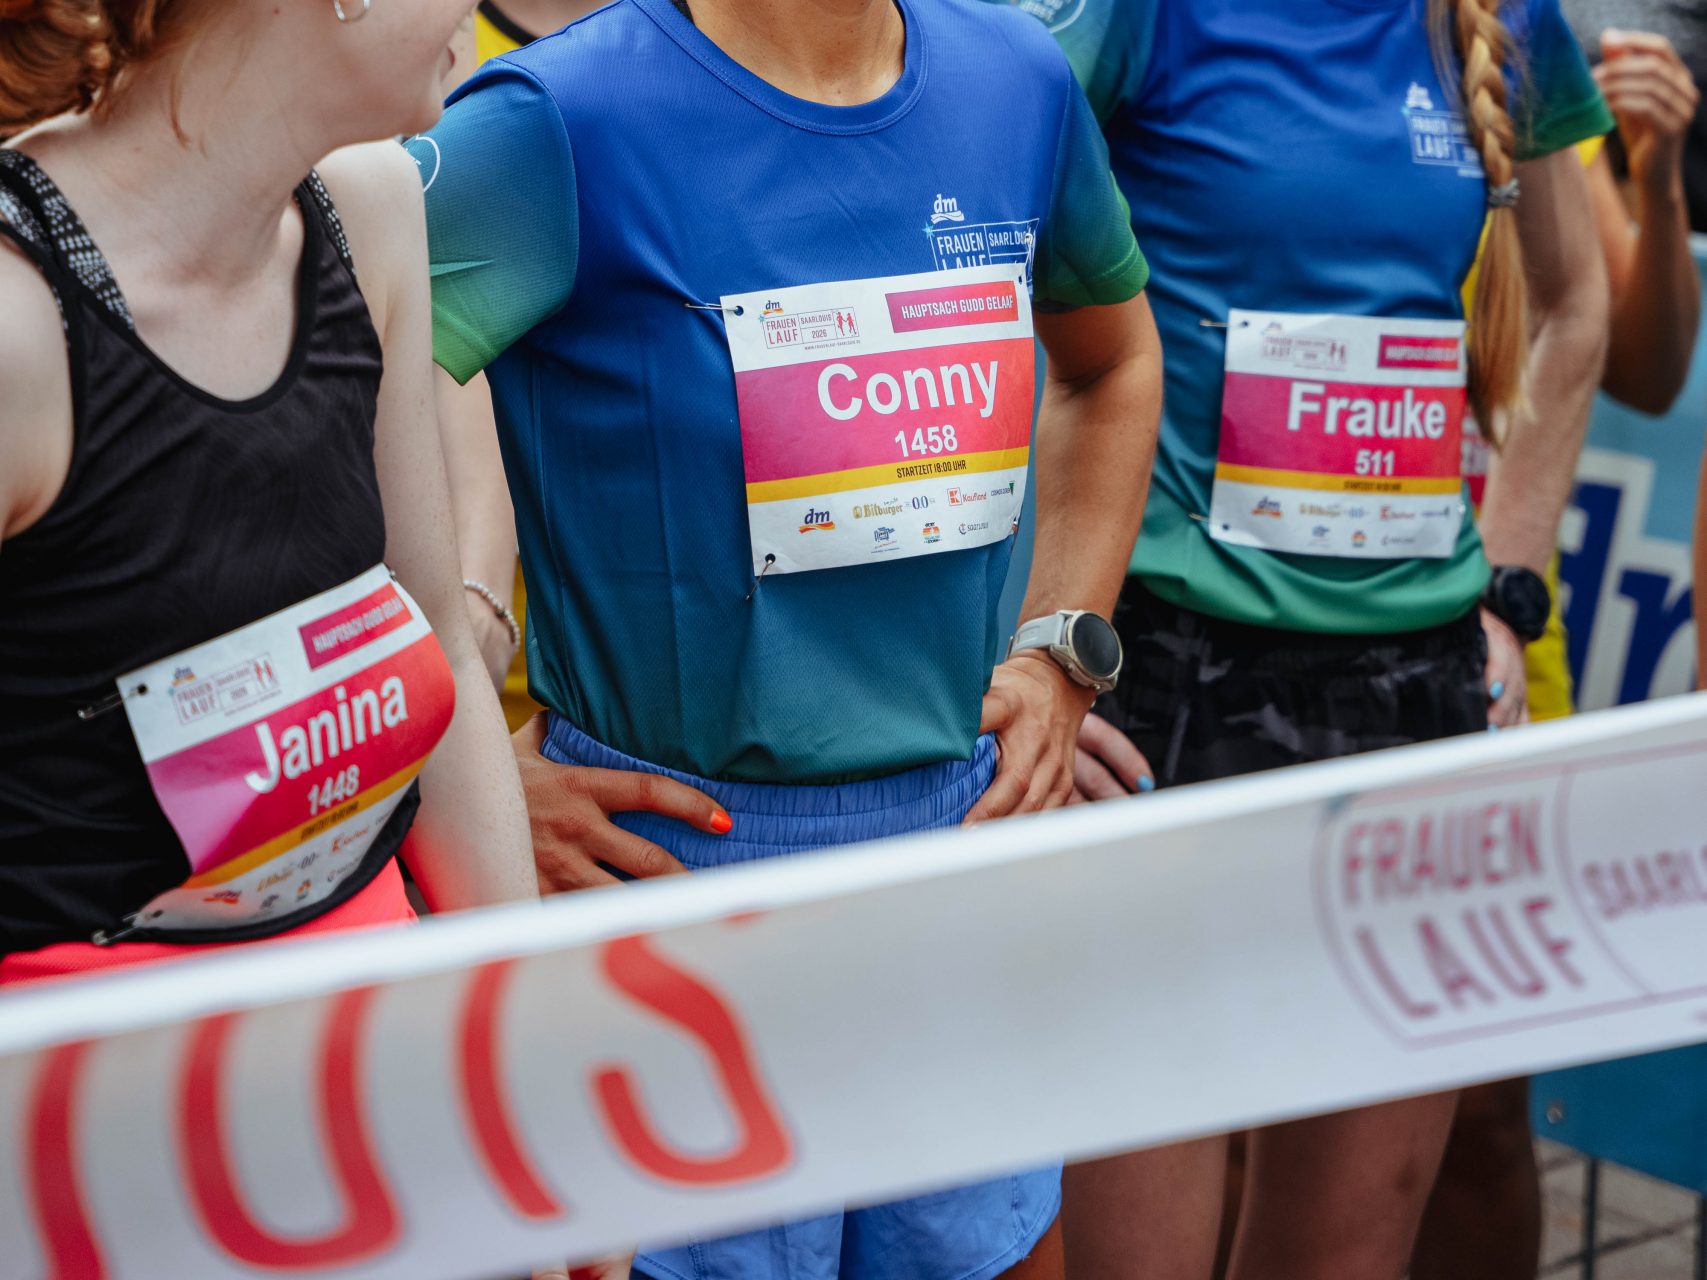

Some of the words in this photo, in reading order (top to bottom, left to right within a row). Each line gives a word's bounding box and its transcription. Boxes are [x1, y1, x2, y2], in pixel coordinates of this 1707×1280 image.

[934, 193, 958, 213] dm
[937, 232, 985, 256] FRAUEN
[766, 300, 780, 310] dm
[902, 300, 959, 320] HAUPTSACH
[960, 297, 985, 313] GUDD
[766, 318, 797, 331] FRAUEN
[800, 314, 832, 325] SAARLOUIS
[768, 329, 799, 345] LAUF
[817, 360, 998, 421] Conny
[1287, 382, 1446, 439] Frauke
[894, 424, 958, 458] 1458
[896, 464, 933, 478] STARTZEIT
[934, 461, 952, 473] 18:00
[953, 460, 967, 471] UHR
[1355, 449, 1394, 476] 511
[963, 491, 987, 503] Kaufland
[804, 508, 830, 524] dm
[863, 503, 903, 518] Bitburger
[181, 694, 215, 720] LAUF
[244, 675, 408, 794] Janina
[307, 763, 361, 816] 1448
[1342, 800, 1546, 908] FRAUEN
[1355, 898, 1585, 1018] LAUF
